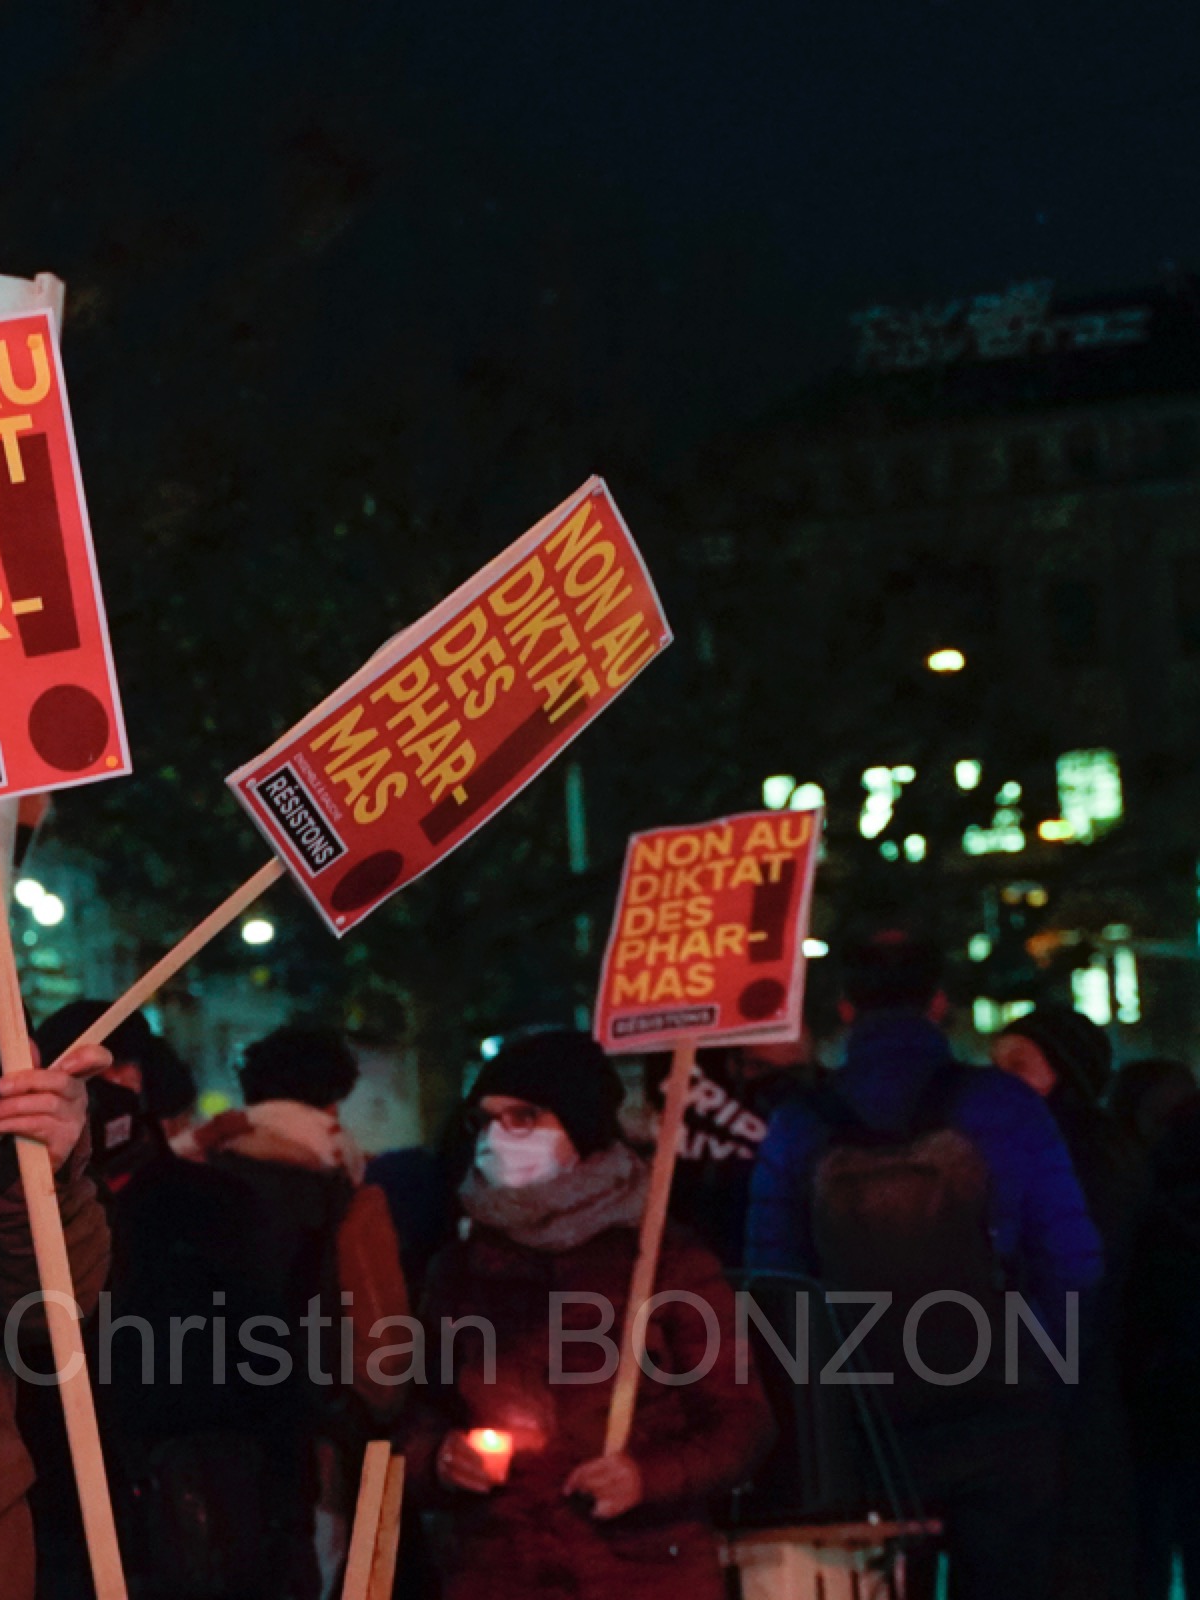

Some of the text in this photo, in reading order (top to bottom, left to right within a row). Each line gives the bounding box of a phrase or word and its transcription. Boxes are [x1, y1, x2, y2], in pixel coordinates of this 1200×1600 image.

[487, 555, 601, 724] DIKTAT
[545, 501, 658, 689] NON AU
[430, 608, 515, 721] DES
[309, 704, 408, 825] MAS
[369, 657, 478, 806] PHAR-
[265, 776, 335, 865] RÉSISTONS
[632, 815, 813, 873] NON AU
[622, 895, 715, 938] DES
[628, 851, 793, 905] DIKTAT
[611, 962, 715, 1007] MAS
[615, 923, 768, 970] PHAR-
